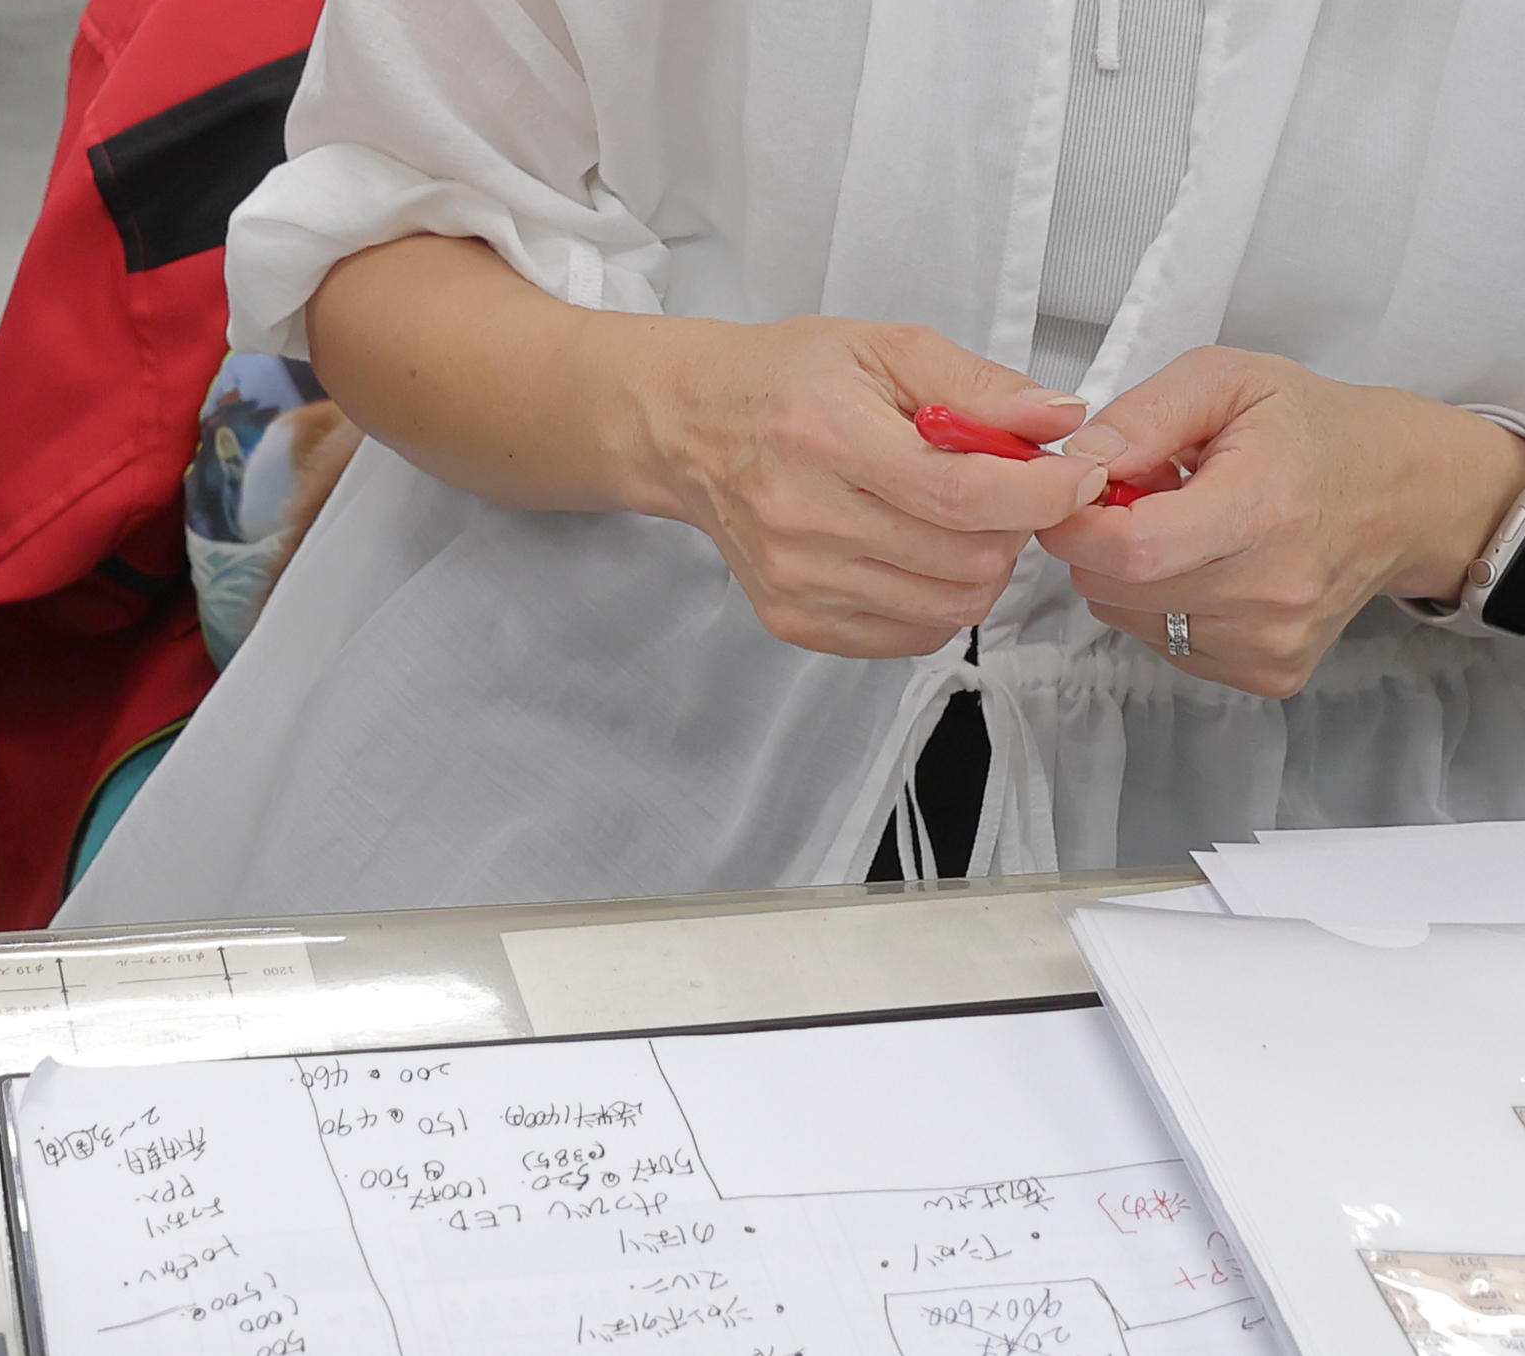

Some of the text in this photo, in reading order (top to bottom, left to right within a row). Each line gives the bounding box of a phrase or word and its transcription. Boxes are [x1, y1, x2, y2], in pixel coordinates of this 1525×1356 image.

[262, 966, 296, 977] 1200
[399, 1062, 451, 1084] 200
[320, 1108, 379, 1136] 490
[416, 1109, 468, 1136] 150
